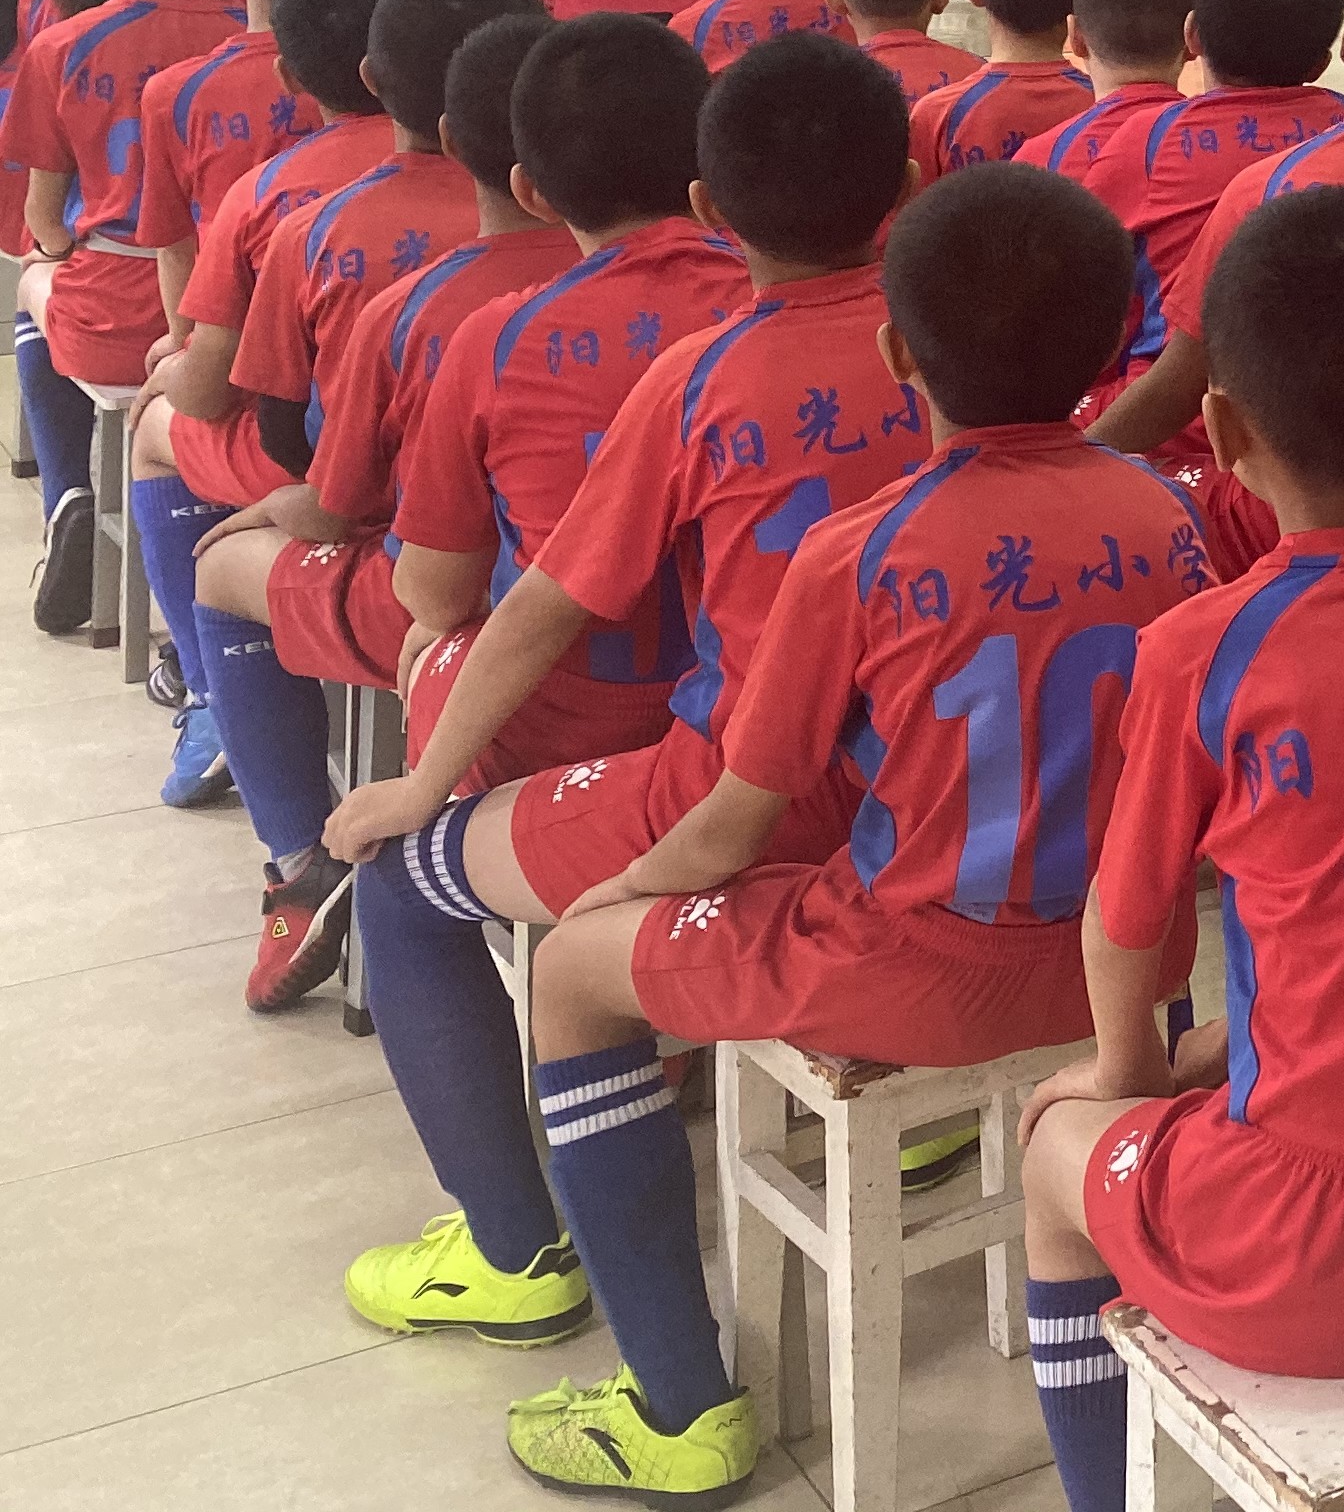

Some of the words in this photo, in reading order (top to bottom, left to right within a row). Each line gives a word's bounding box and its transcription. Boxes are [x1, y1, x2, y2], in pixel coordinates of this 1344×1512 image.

[1179, 113, 1344, 161] 阳光小
[878, 524, 1207, 638] 阳光小学
